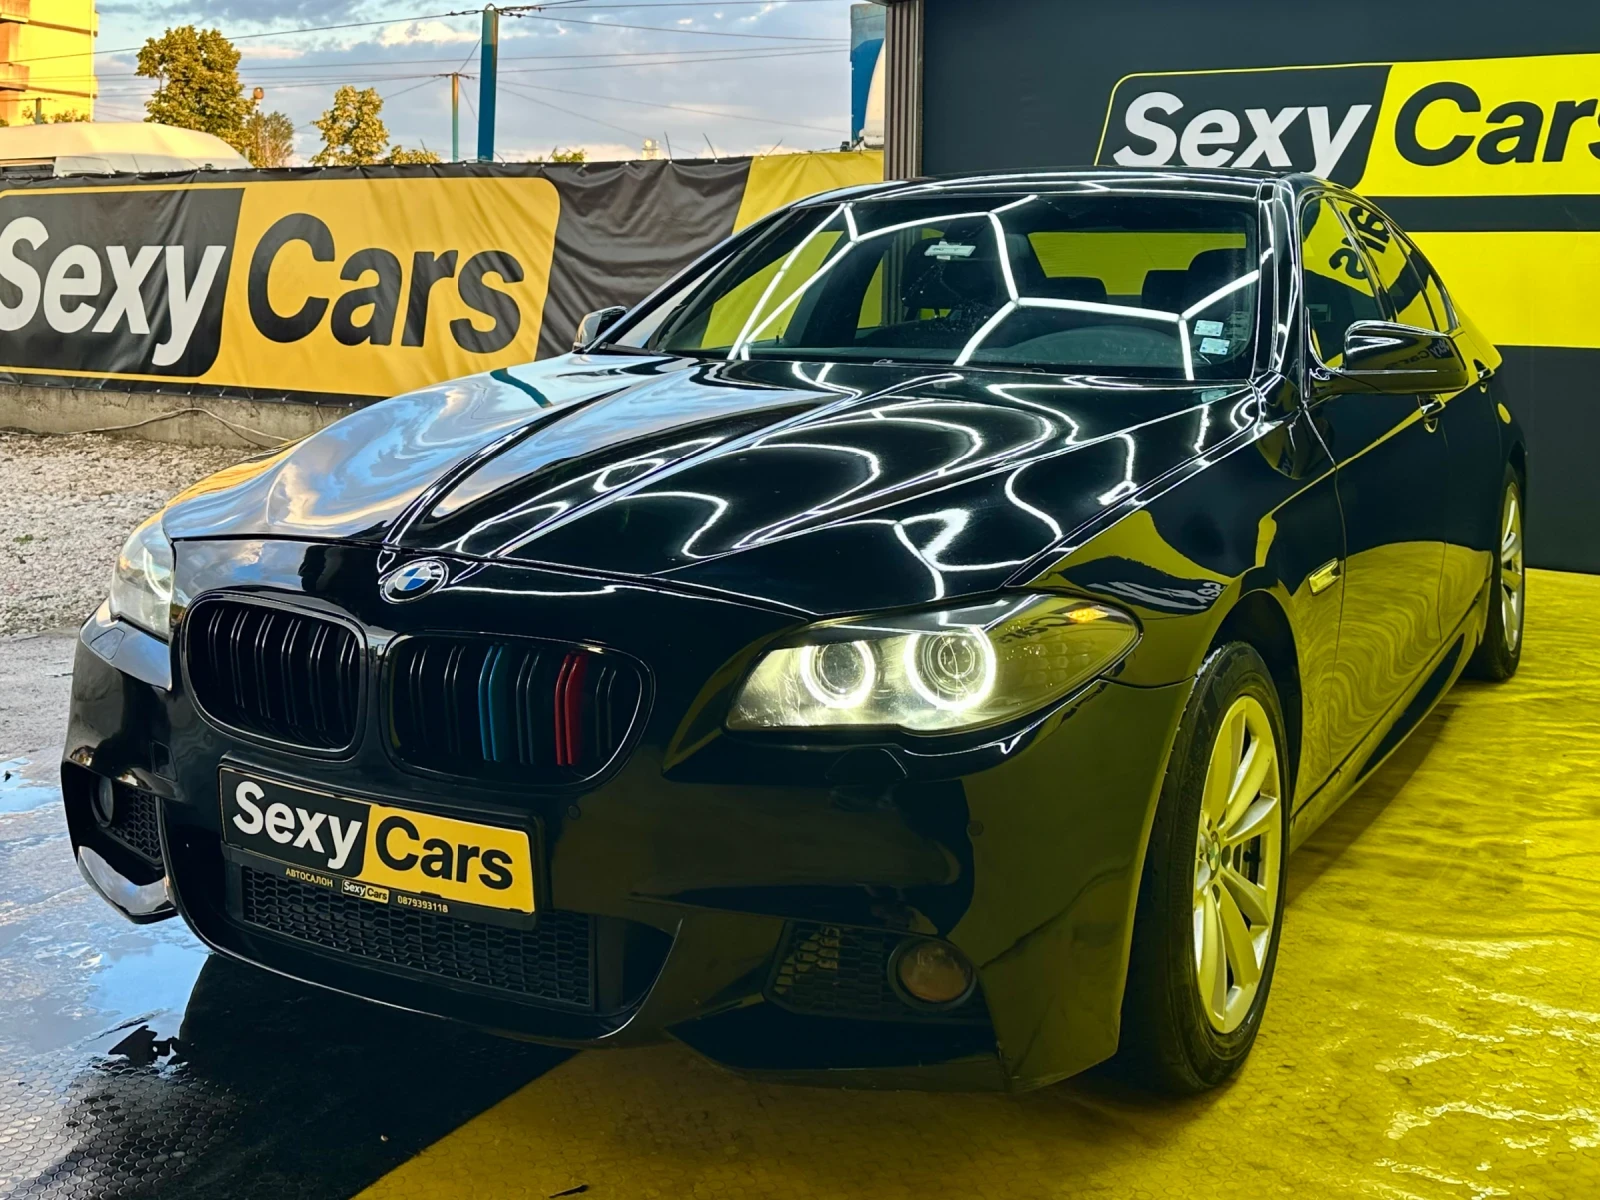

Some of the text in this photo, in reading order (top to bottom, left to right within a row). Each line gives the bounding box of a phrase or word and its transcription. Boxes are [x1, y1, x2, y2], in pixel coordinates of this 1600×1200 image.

[1113, 81, 1600, 180] Sexy Car
[0, 212, 525, 366] Sexy Cars
[232, 781, 513, 890] Sexy Cars
[286, 868, 333, 888] АВТОСАЛОН
[343, 881, 388, 901] Sexy Cars
[397, 896, 448, 913] 0879393118
